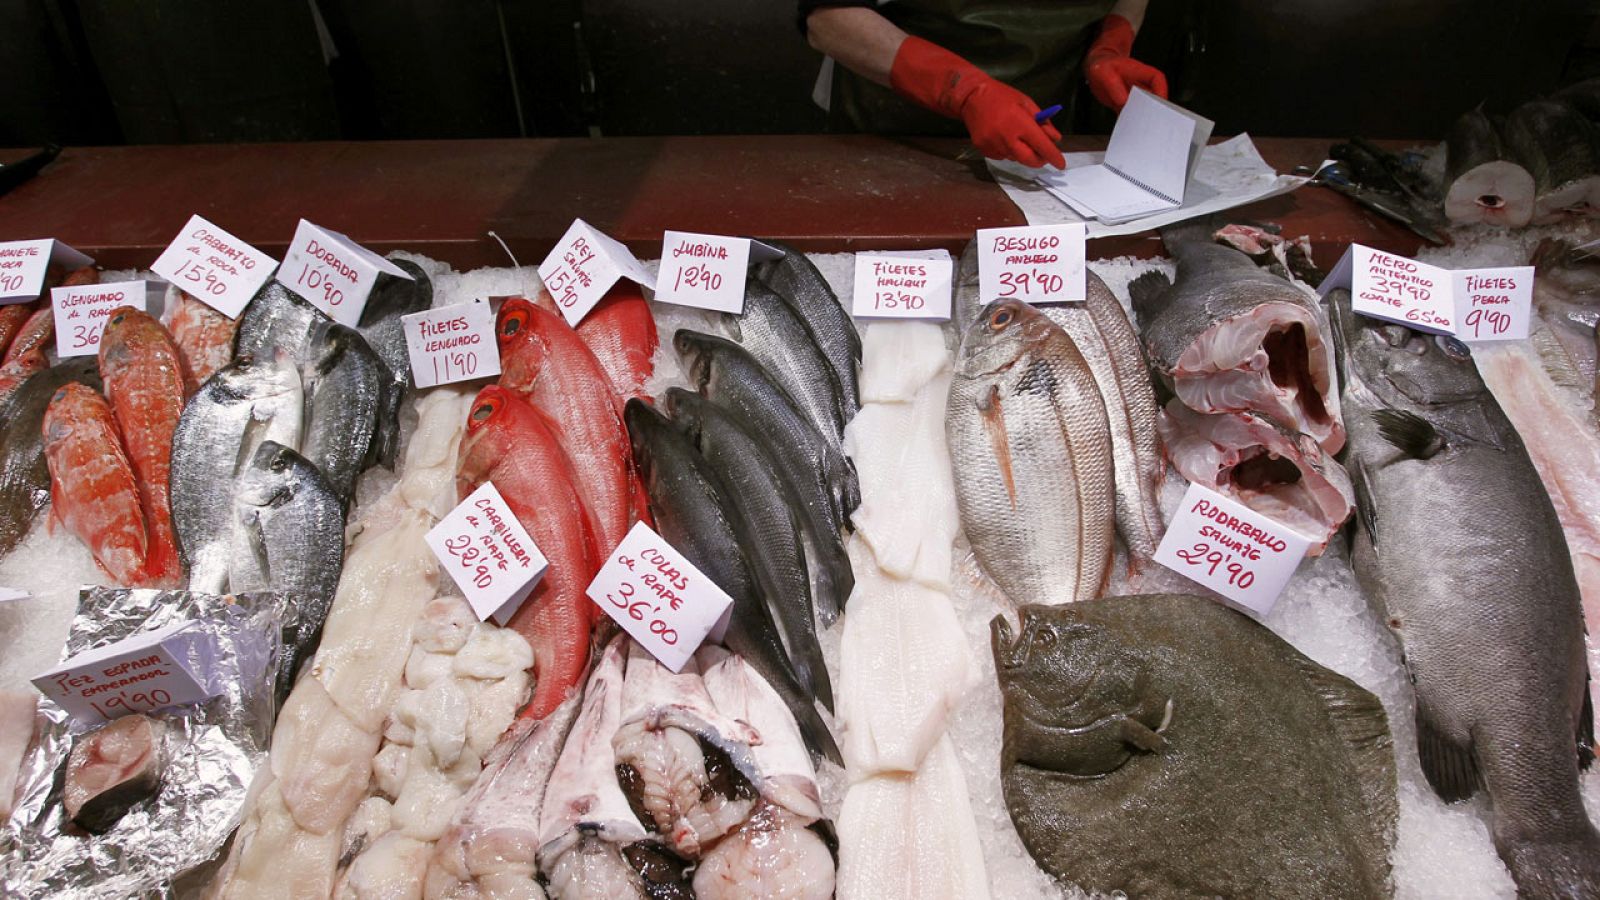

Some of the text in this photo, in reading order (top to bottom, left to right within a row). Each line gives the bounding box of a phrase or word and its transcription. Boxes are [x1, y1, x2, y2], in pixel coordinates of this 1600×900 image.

[571, 237, 596, 266] REY
[673, 240, 728, 260] LUBINA
[993, 236, 1060, 253] BESUGO
[306, 240, 359, 283] DORADA
[873, 261, 927, 276] FILETES
[1005, 254, 1058, 265] ANZUELO
[1369, 253, 1417, 273] MERO
[174, 259, 227, 295] 15'90
[298, 263, 344, 306] 10'90
[544, 265, 578, 307] 15'90
[674, 264, 722, 292] 12'90
[998, 268, 1063, 296] 39'90
[1370, 275, 1431, 300] 39'90
[1465, 275, 1517, 292] FILETES
[60, 291, 125, 310] LENGUADO
[874, 291, 925, 310] 13'90
[1360, 291, 1403, 308] CORTE
[1472, 294, 1511, 306] PERCA
[418, 316, 470, 340] FILETES
[1405, 308, 1450, 326] 65'00
[1465, 309, 1511, 338] 9'90
[425, 333, 481, 352] LENGUADO
[433, 351, 478, 384] 11'90
[1190, 499, 1288, 553] RODABALLO
[444, 534, 493, 589] 22'90
[479, 535, 509, 572] RAPE
[1175, 543, 1256, 590] 29'90
[640, 548, 689, 591] COLAS
[640, 573, 685, 611] RAPE
[606, 581, 679, 646] 36'00
[50, 655, 162, 693] PEZ ESPADA
[81, 669, 171, 698] EMPERADOR
[89, 688, 171, 720] 19'90
